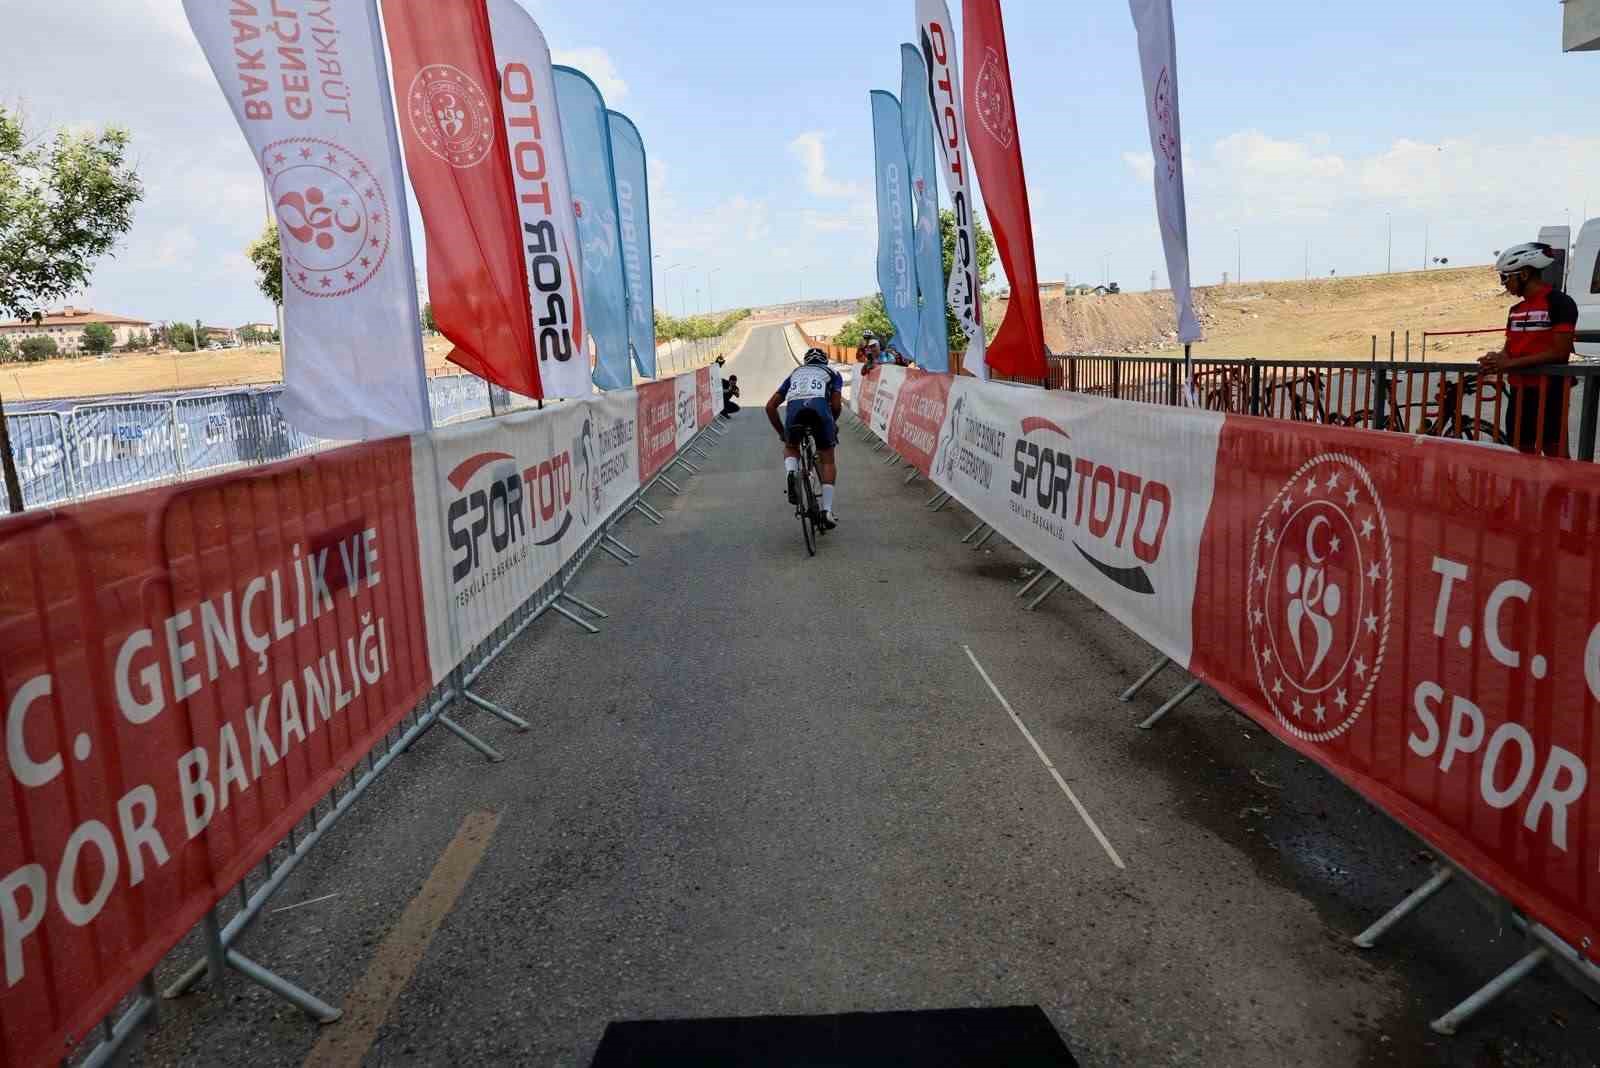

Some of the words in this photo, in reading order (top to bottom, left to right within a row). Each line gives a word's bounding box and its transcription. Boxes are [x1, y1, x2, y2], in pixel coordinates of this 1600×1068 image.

[115, 543, 334, 725] GENÇLİK
[340, 528, 381, 598] VE
[1431, 556, 1548, 680] T.C.
[0, 783, 171, 988] POR
[177, 611, 389, 840] BAKANLIĞI
[1408, 680, 1588, 852] SPOR
